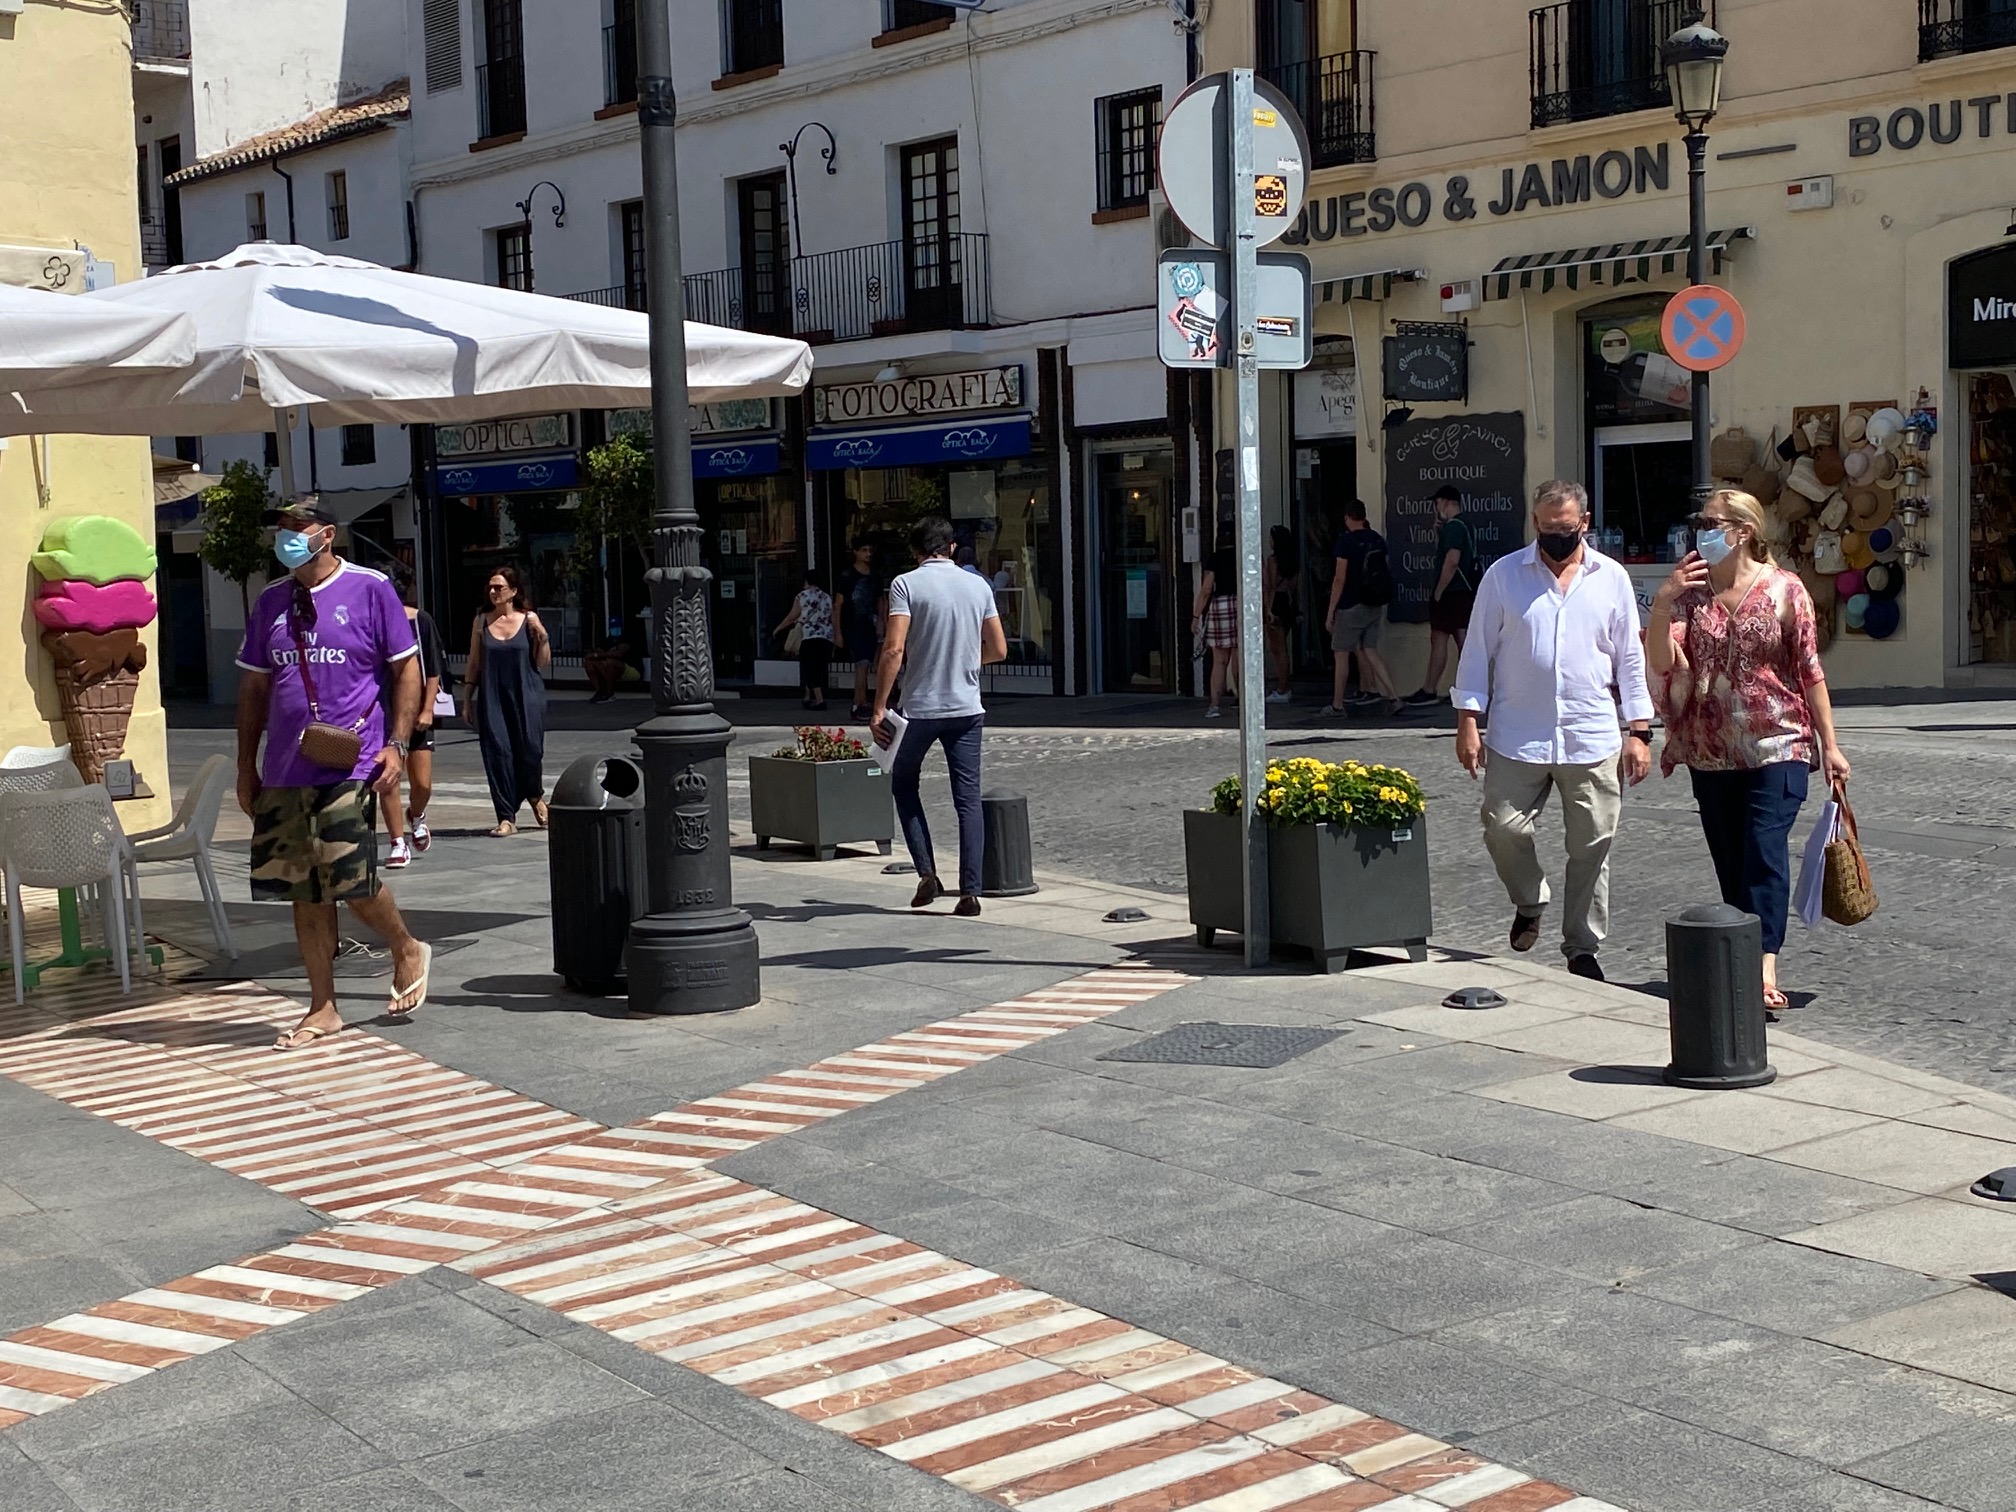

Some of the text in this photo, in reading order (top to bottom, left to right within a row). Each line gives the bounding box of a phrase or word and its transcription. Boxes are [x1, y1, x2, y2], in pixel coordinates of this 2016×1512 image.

[1280, 141, 1669, 246] QUESO & JAMON
[1398, 347, 1423, 371] Queso
[823, 372, 1014, 421] FOTOGRAFIA
[462, 421, 535, 452] OPTICA
[941, 437, 990, 449] OPTICA BACA
[1432, 423, 1461, 461] &
[833, 448, 855, 458] OPTICA
[1419, 465, 1488, 481] BOUTIQUE
[1460, 490, 1513, 513] Morcillas
[1408, 525, 1436, 544] Vino
[1397, 581, 1433, 602] Produ
[271, 645, 346, 666] Emrates
